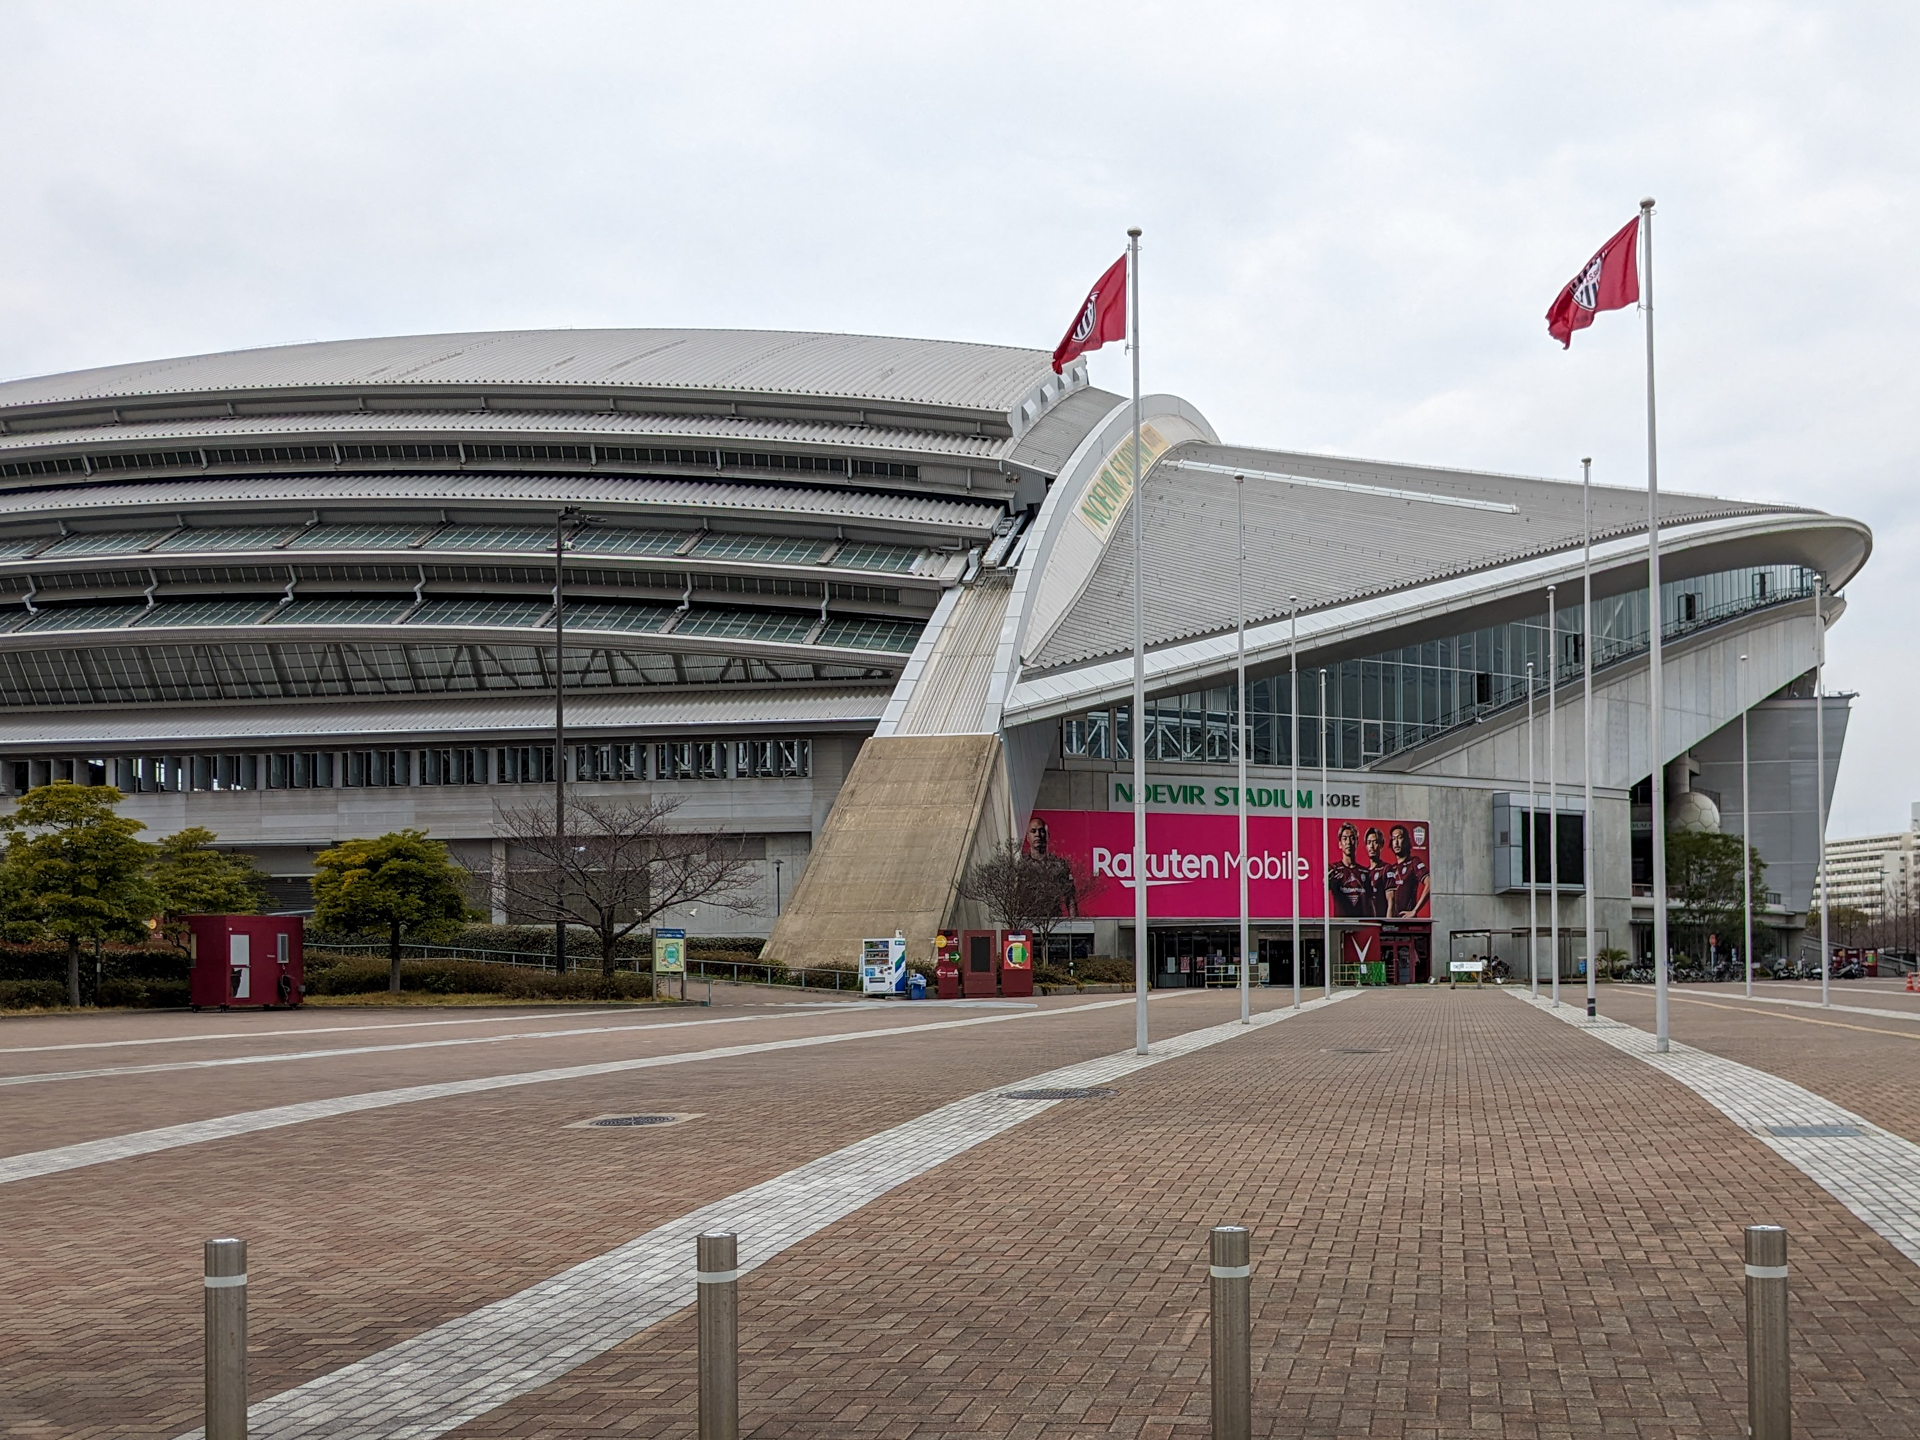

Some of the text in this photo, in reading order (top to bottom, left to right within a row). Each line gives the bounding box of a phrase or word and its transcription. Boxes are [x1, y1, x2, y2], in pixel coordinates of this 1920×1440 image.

[1081, 470, 1127, 531] NOEVIR
[1214, 786, 1313, 809] STADIUM
[1320, 793, 1361, 808] KOBE
[1224, 850, 1310, 881] Mobile
